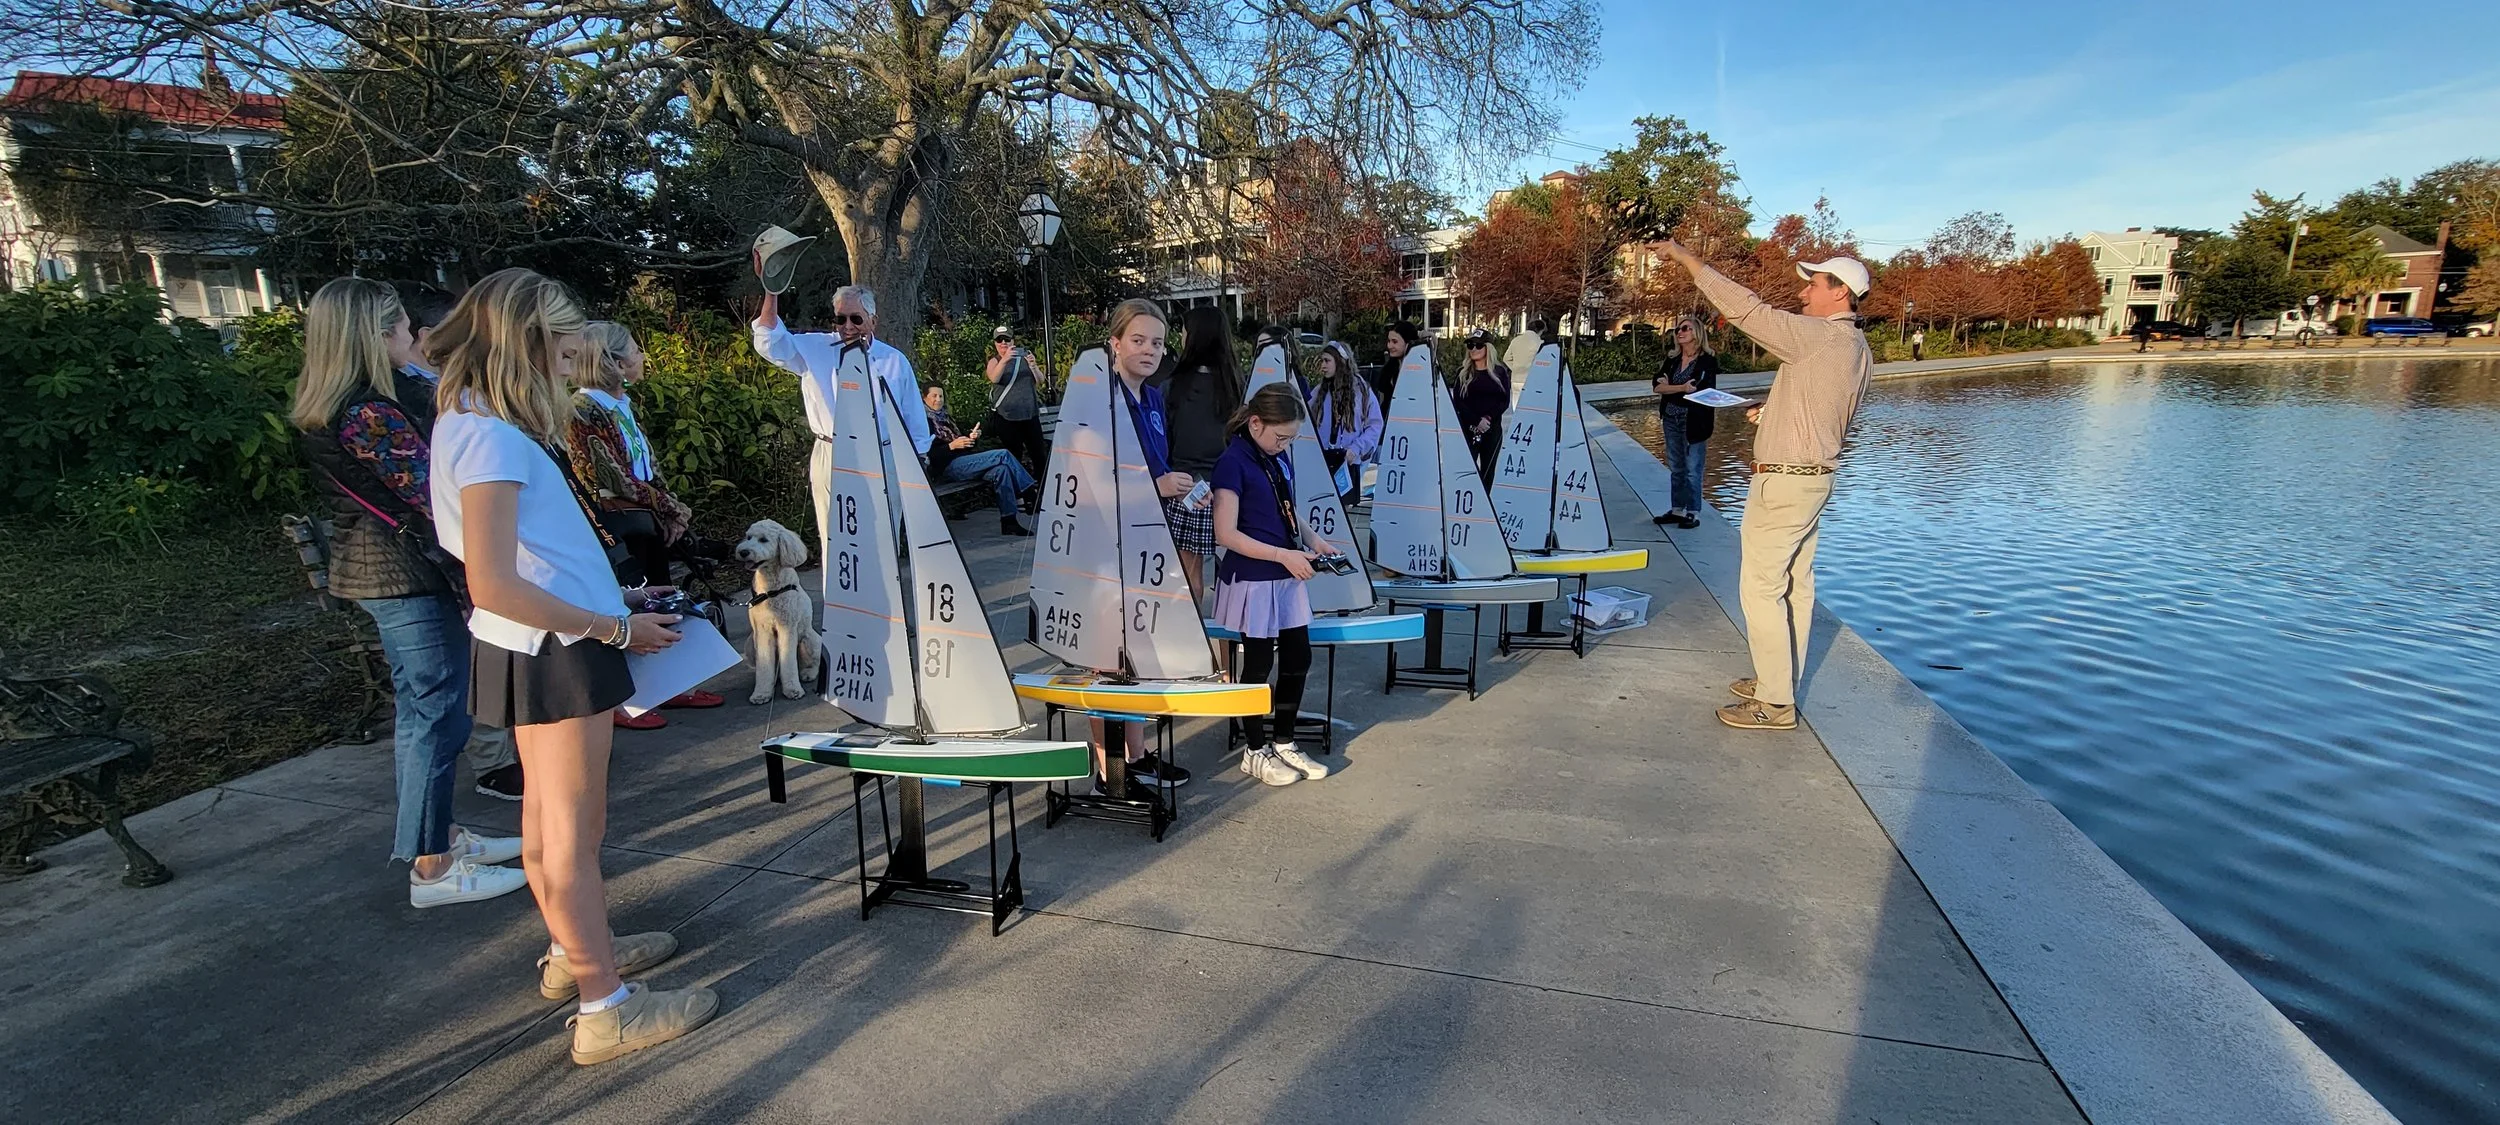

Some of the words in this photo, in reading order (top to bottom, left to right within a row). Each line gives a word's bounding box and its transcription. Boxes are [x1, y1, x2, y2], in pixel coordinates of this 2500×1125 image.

[1510, 423, 1533, 446] 44
[1390, 435, 1409, 461] 10
[1055, 473, 1077, 508] 13
[1563, 470, 1587, 493] 44
[837, 494, 858, 536] 18
[1456, 489, 1474, 515] 10
[1309, 505, 1336, 536] 66
[1502, 527, 1520, 543] HS
[1140, 551, 1165, 587] 13
[1408, 560, 1438, 573] AHS
[927, 582, 955, 623] 18
[1046, 606, 1082, 630] AHS
[836, 653, 875, 677] AHS
